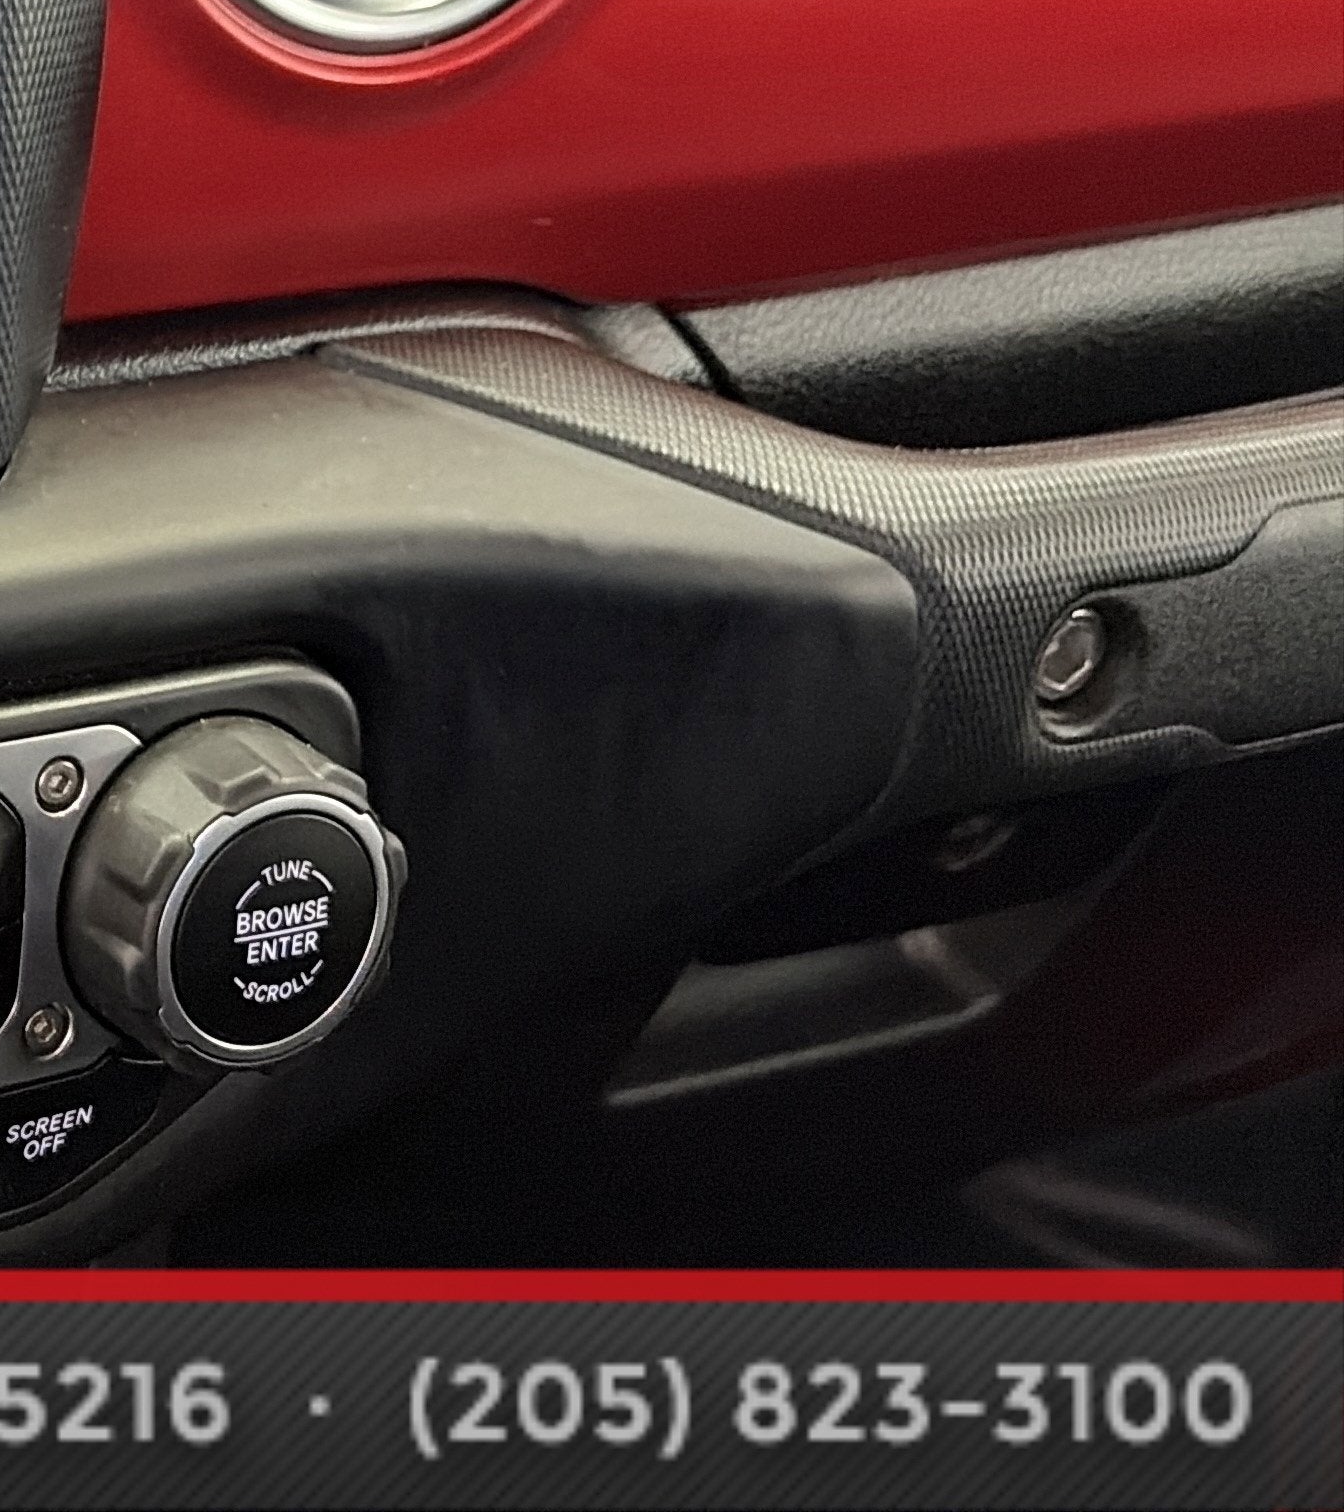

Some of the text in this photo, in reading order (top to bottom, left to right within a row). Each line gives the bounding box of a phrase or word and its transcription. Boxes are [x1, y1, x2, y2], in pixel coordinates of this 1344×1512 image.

[261, 859, 313, 886] TUNE
[236, 896, 329, 935] BROWSE
[247, 931, 319, 964] ENTER
[243, 972, 314, 1003] SCROLL
[6, 1104, 93, 1143] SCREEN
[23, 1131, 70, 1162] OFF
